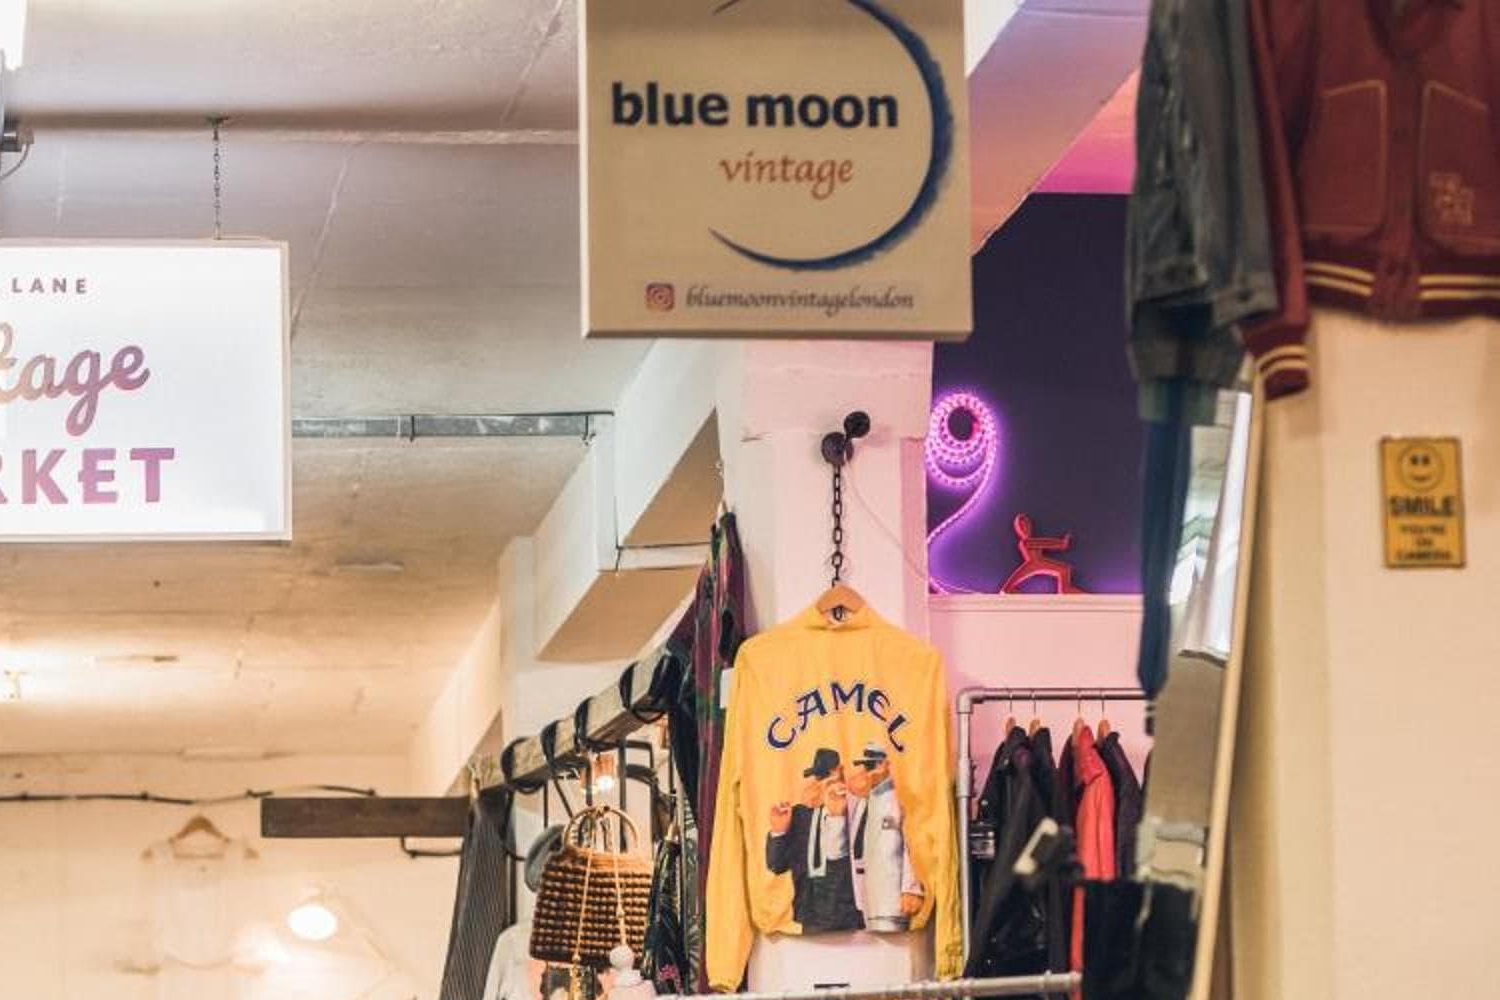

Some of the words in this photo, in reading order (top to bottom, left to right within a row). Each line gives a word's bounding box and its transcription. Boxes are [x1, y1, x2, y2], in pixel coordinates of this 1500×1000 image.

[611, 82, 730, 127] blue
[746, 93, 899, 128] moon
[719, 151, 855, 200] vintage
[11, 276, 89, 295] LANE
[685, 285, 915, 318] bluemoonvintagelondon
[1389, 496, 1455, 518] SMILE
[767, 682, 908, 752] CAMEL
